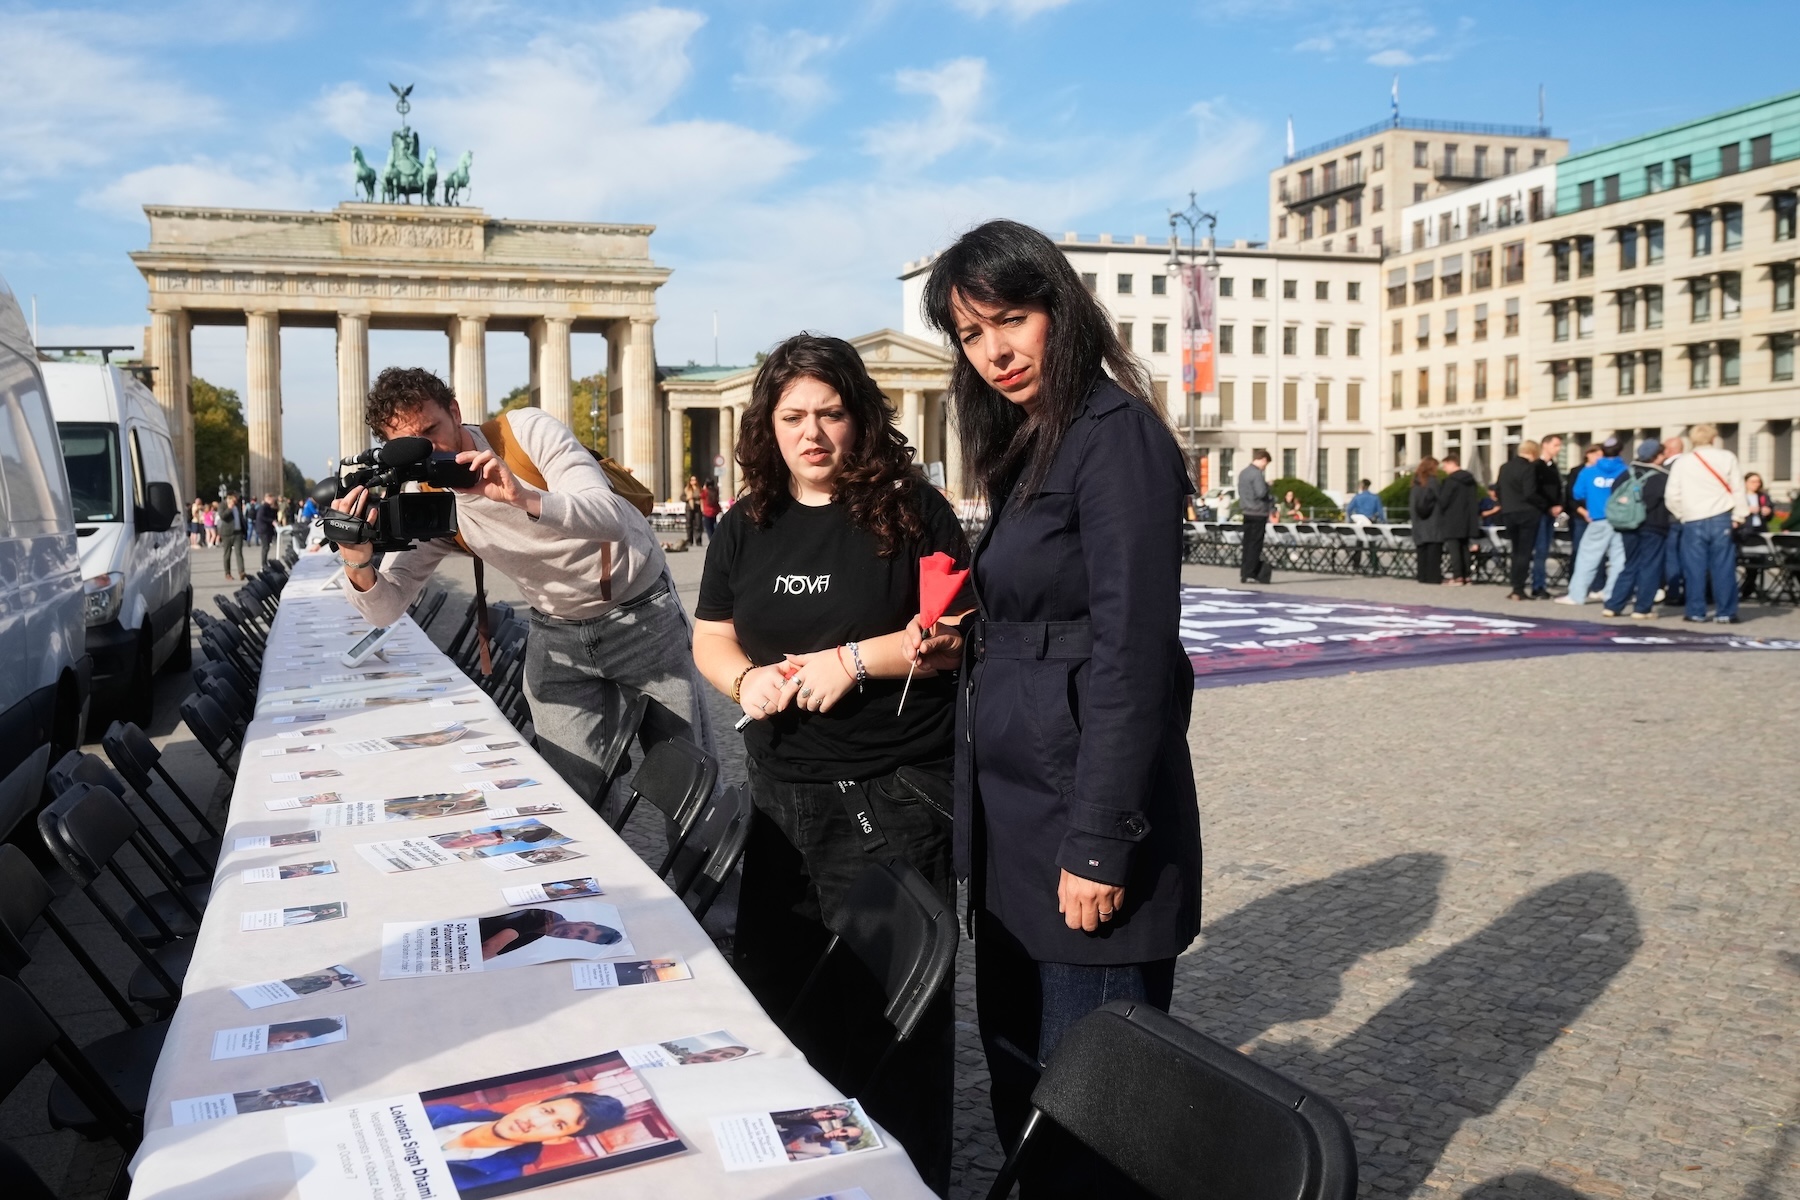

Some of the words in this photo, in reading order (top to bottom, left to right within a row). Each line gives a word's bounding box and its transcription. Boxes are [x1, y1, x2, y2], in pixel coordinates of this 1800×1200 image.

[329, 520, 350, 530] SONY
[773, 574, 832, 595] NOVA
[856, 811, 873, 834] L1K3
[430, 927, 439, 936] was
[444, 923, 454, 941] Platoon
[458, 933, 468, 945] Tomer
[430, 950, 440, 958] and
[444, 941, 455, 965] commander
[445, 965, 454, 973] who
[348, 1109, 362, 1129] Hamas
[369, 1111, 385, 1137] Nepalese
[354, 1129, 370, 1155] terrorists
[389, 1104, 413, 1140] Lokendra
[403, 1141, 424, 1167] Singh
[337, 1142, 347, 1151] on
[378, 1137, 393, 1160] student
[339, 1151, 353, 1174] October
[362, 1154, 372, 1162] in
[364, 1161, 380, 1186] Kibbutz
[384, 1159, 406, 1192] murdered
